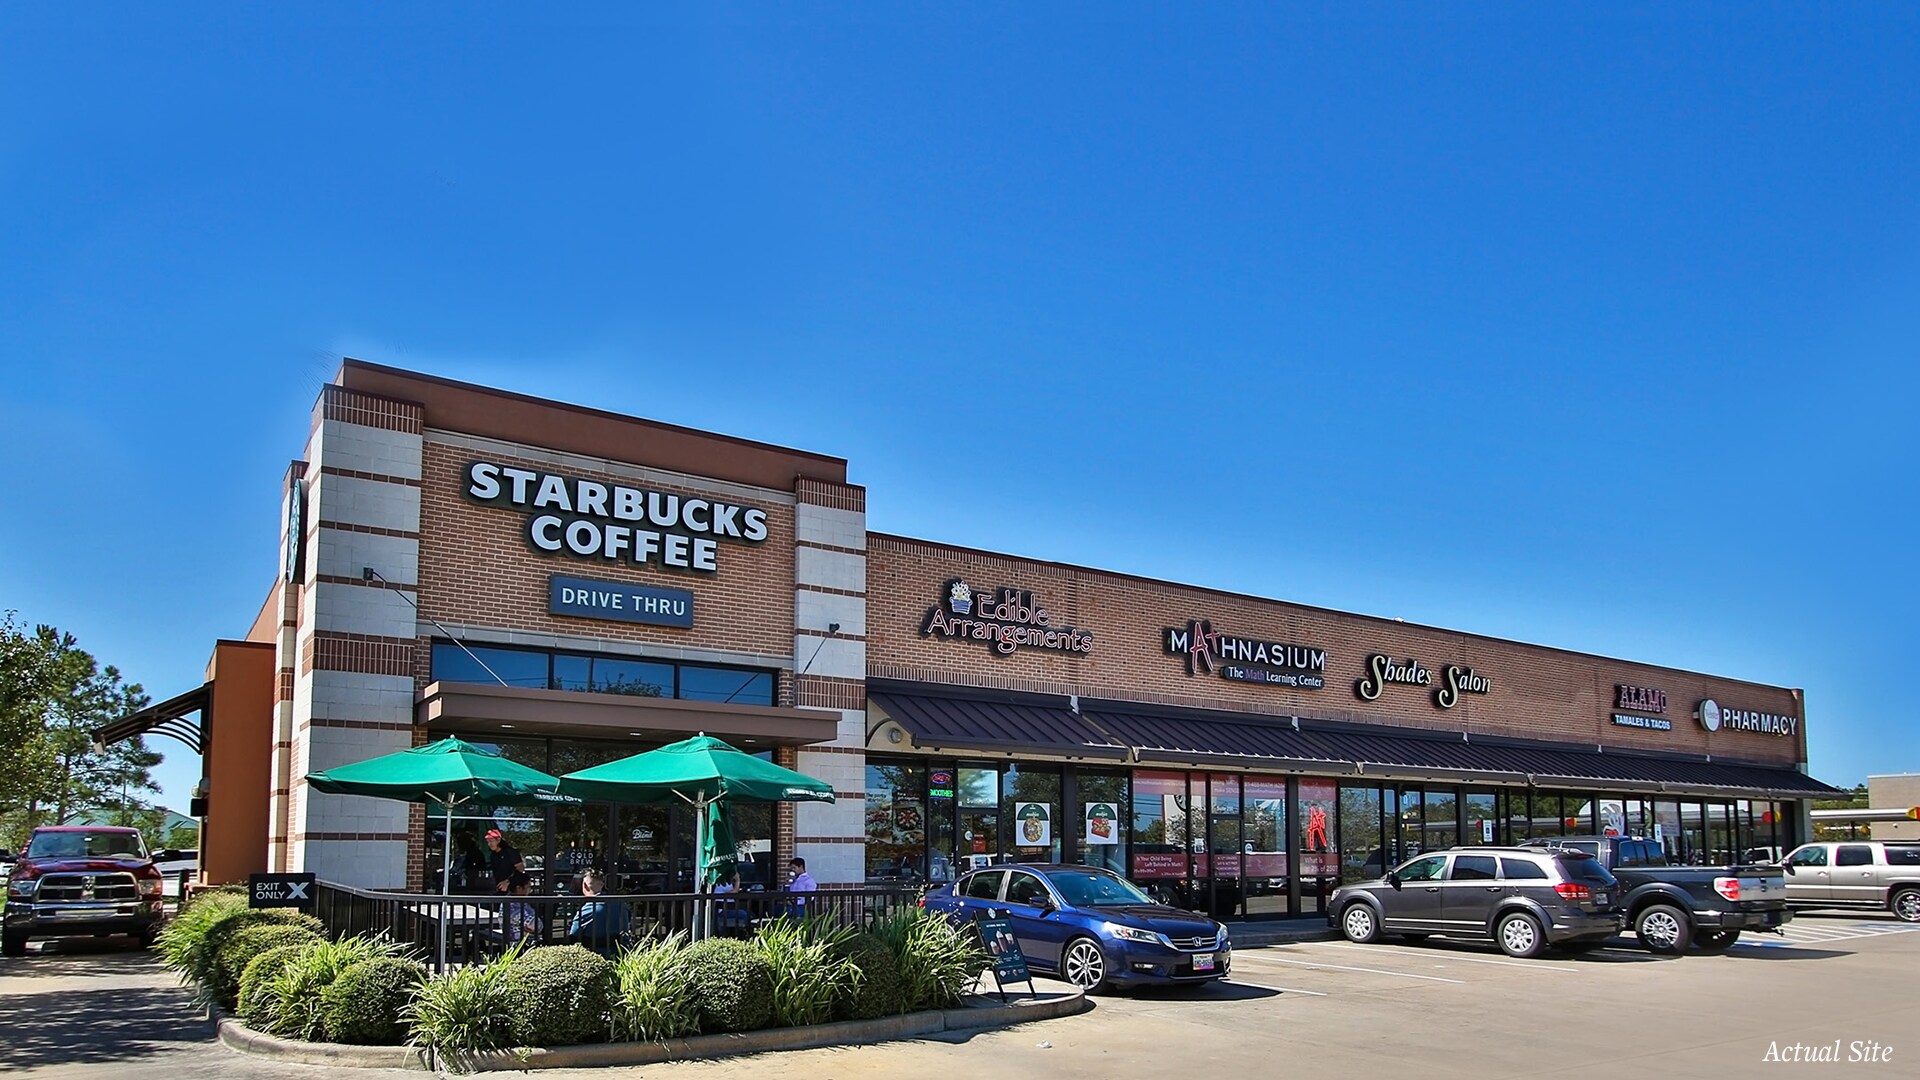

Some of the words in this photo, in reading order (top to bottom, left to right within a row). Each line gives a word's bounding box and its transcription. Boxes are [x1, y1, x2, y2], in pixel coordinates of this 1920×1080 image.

[469, 462, 769, 541] STARBUCKS
[531, 515, 718, 571] COFFEE
[561, 588, 623, 609] DRIVE
[632, 596, 685, 616] THRU
[976, 589, 1049, 626] Edible
[927, 608, 1093, 654] Arrangements
[1228, 666, 1244, 679] The
[1245, 669, 1265, 681] Math
[1266, 671, 1297, 687] Learning
[1298, 675, 1322, 687] Center
[1360, 655, 1432, 700] Shades
[1438, 666, 1491, 708] Salon
[1619, 685, 1668, 713] ALAMO
[1615, 715, 1644, 727] TAMALES
[1644, 719, 1650, 727] &
[1651, 719, 1671, 730] TACOS
[1723, 708, 1797, 736] PHARMACY
[255, 891, 285, 900] ONLY
[256, 882, 280, 891] EXIT
